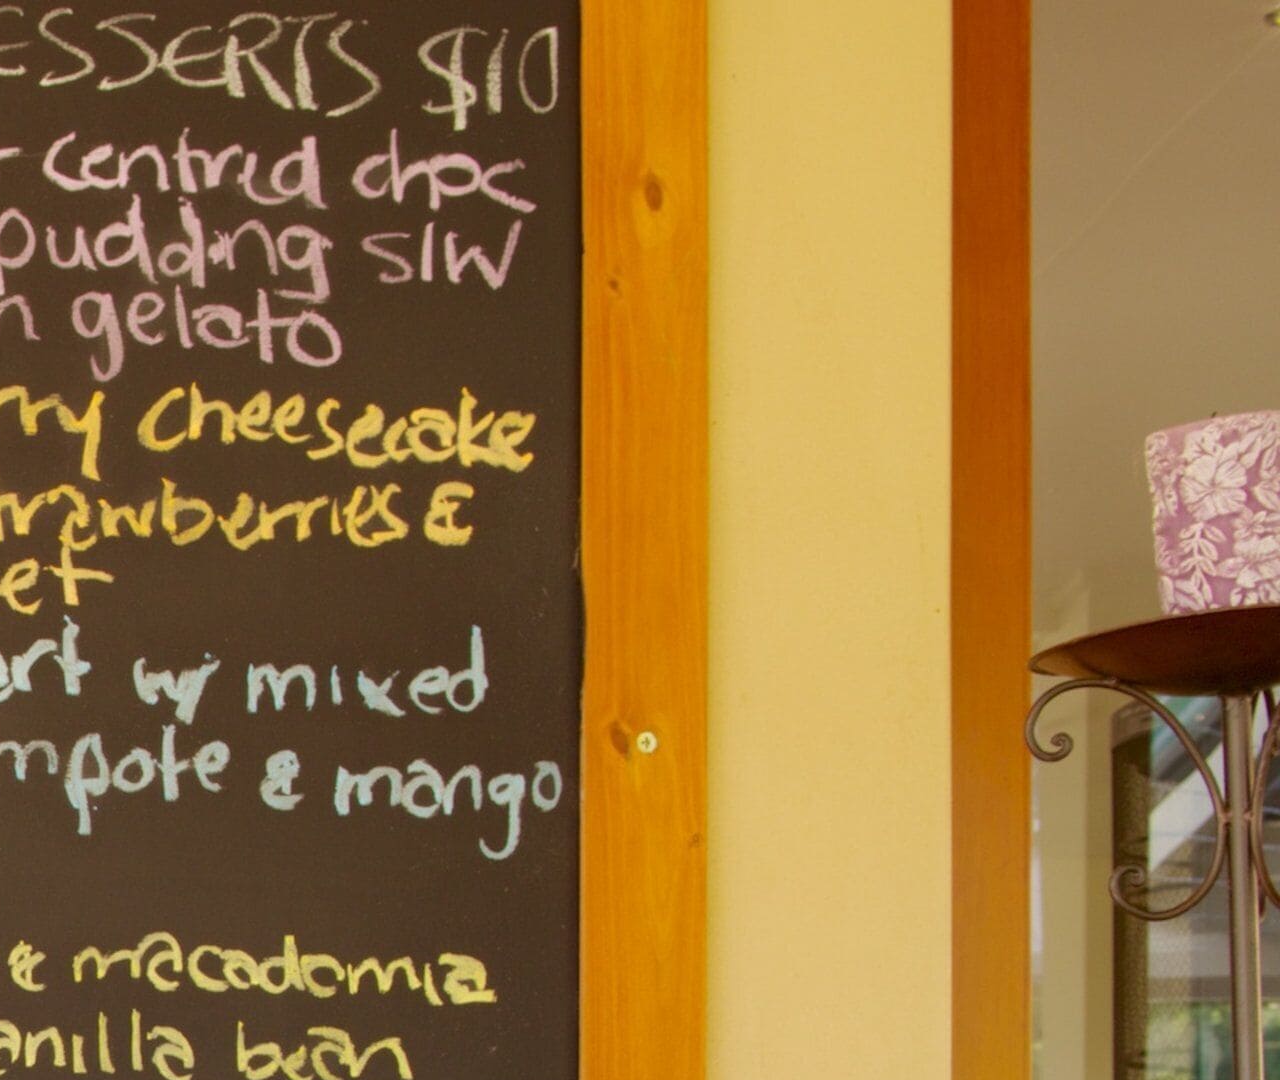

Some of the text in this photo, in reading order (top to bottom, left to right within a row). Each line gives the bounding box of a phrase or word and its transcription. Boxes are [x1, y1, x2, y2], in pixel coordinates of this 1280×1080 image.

[418, 25, 558, 131] $10
[71, 284, 343, 382] gelato
[247, 625, 489, 717] mixed
[334, 758, 561, 860] mango
